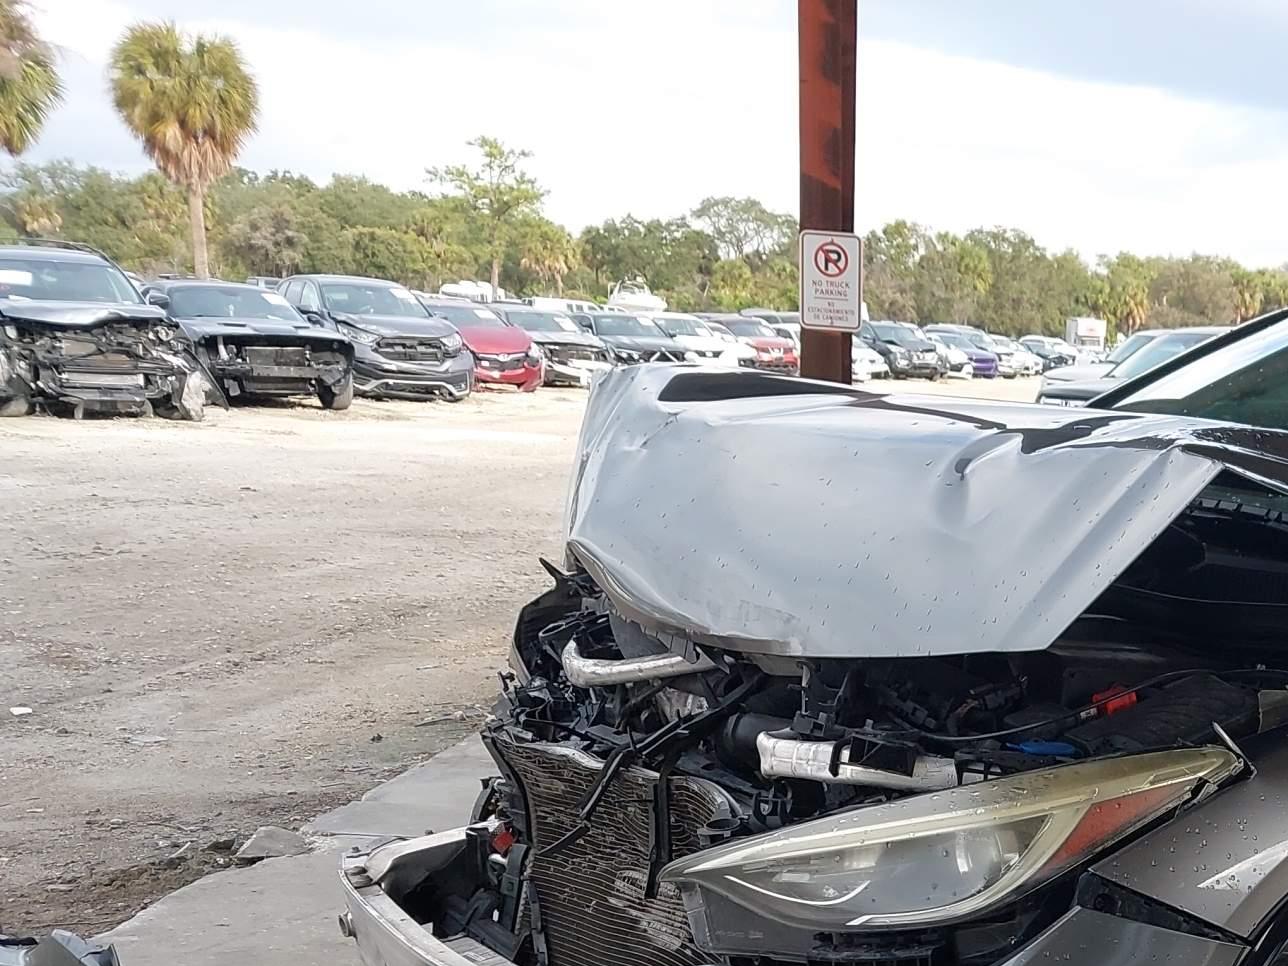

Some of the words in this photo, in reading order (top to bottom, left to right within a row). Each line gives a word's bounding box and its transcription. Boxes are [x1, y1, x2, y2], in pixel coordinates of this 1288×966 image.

[824, 249, 842, 272] P
[811, 280, 823, 288] NO
[826, 280, 850, 289] TRUCK
[814, 288, 848, 297] PARKING
